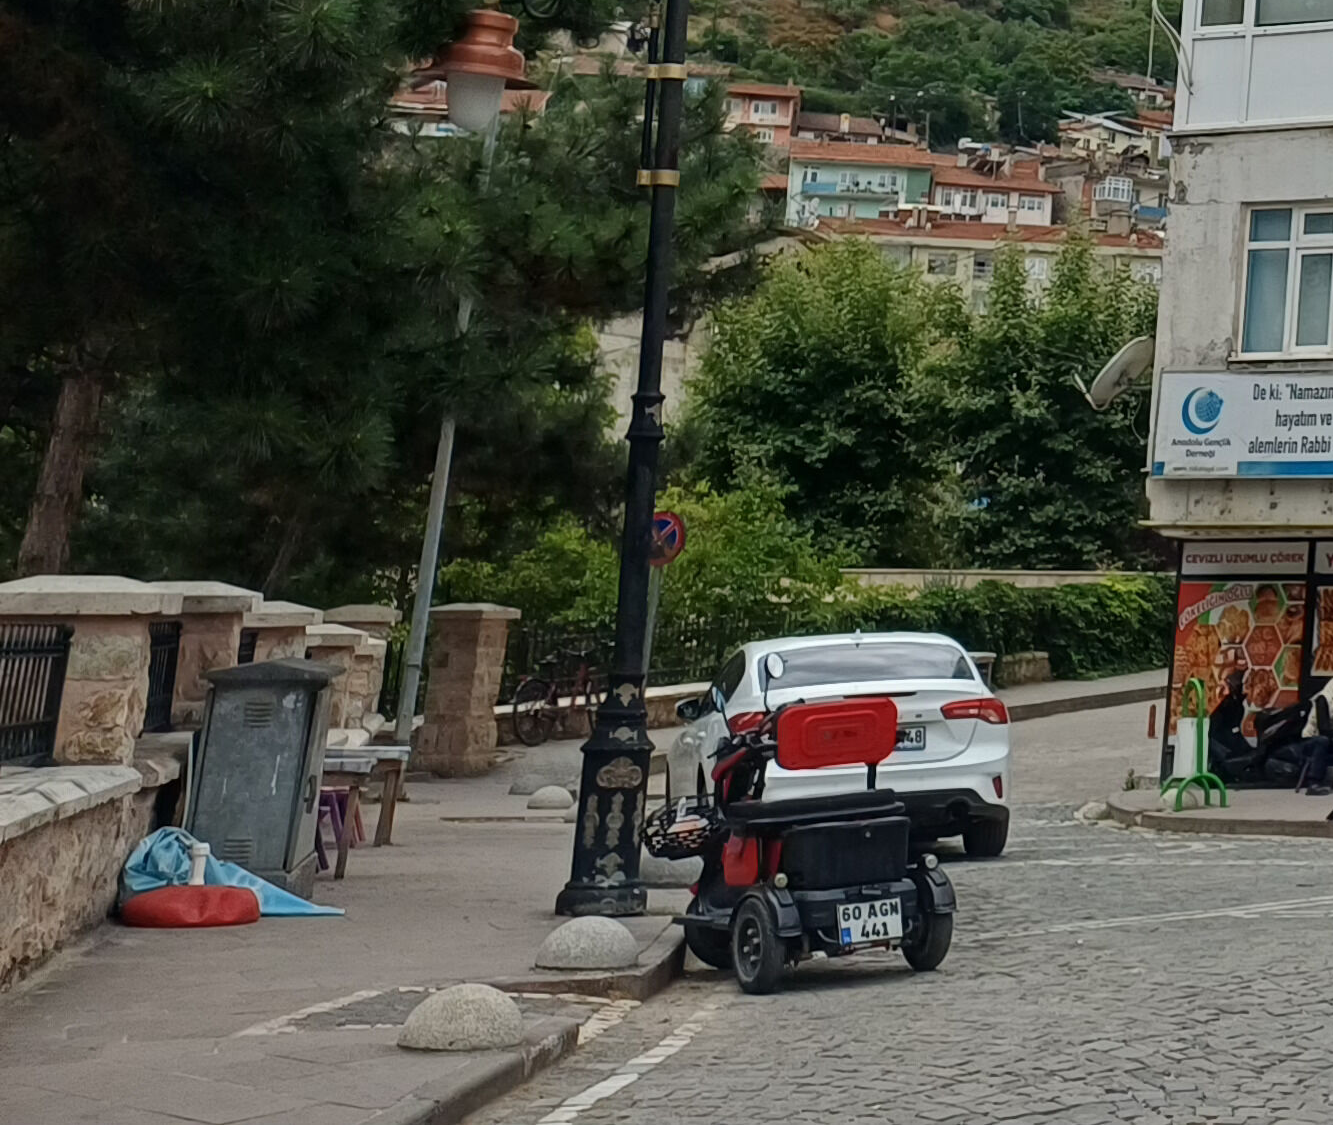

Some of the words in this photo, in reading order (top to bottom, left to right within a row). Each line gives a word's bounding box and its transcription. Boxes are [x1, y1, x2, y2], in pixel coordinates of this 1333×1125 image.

[1253, 384, 1269, 401] De
[1275, 409, 1317, 428] hayatım
[1320, 413, 1333, 426] ve
[1248, 435, 1298, 455] alemlerin
[1301, 434, 1332, 454] Rabbi
[842, 906, 862, 922] 60
[868, 901, 899, 919] AGN
[861, 922, 889, 939] 441
